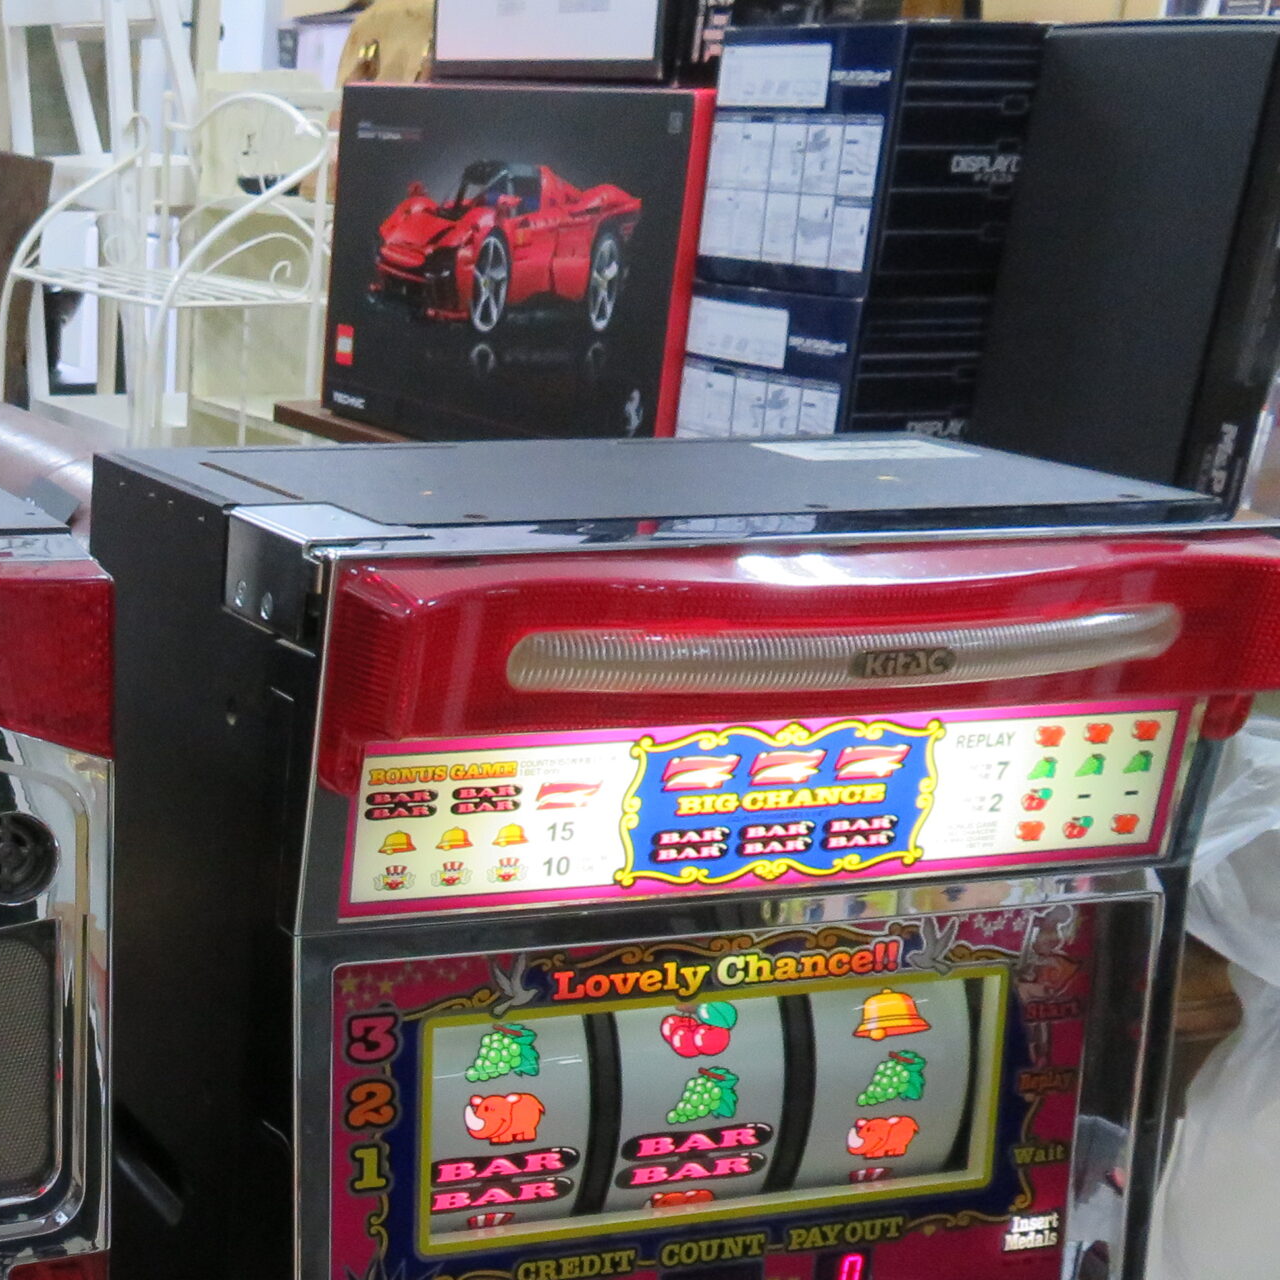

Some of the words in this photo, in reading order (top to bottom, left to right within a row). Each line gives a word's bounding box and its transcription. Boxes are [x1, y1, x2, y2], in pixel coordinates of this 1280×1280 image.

[956, 731, 1016, 749] REPLAY
[368, 765, 448, 786] BONUS
[449, 761, 519, 781] GAME
[997, 761, 1010, 780] 7
[373, 789, 432, 803] BAR
[460, 785, 516, 799] BAR
[675, 793, 740, 816] BIG
[741, 783, 887, 812] CHANCE
[988, 794, 1003, 812] 2
[372, 803, 430, 818] BAR
[457, 799, 514, 813] BAR
[547, 822, 575, 842] 15
[659, 828, 722, 844] BAR
[746, 822, 808, 839] BAR
[831, 816, 892, 832] BAR
[656, 844, 720, 861] BAR
[743, 839, 806, 855] BAR
[827, 833, 888, 849] BAR
[543, 856, 571, 877] 10
[554, 962, 711, 1000] Lovely
[717, 940, 900, 986] Chance!!
[1026, 1001, 1079, 1018] Start
[350, 1016, 395, 1061] 3
[347, 1081, 394, 1127] 2
[636, 1127, 759, 1157] BAR
[1014, 1145, 1065, 1164] Wait
[354, 1147, 387, 1190] 1
[437, 1152, 565, 1183] BAR
[629, 1157, 752, 1186] BAR
[431, 1181, 559, 1212] BAR
[1011, 1211, 1059, 1233] Insert
[662, 1233, 765, 1266] COUNT
[1004, 1229, 1058, 1252] Medals
